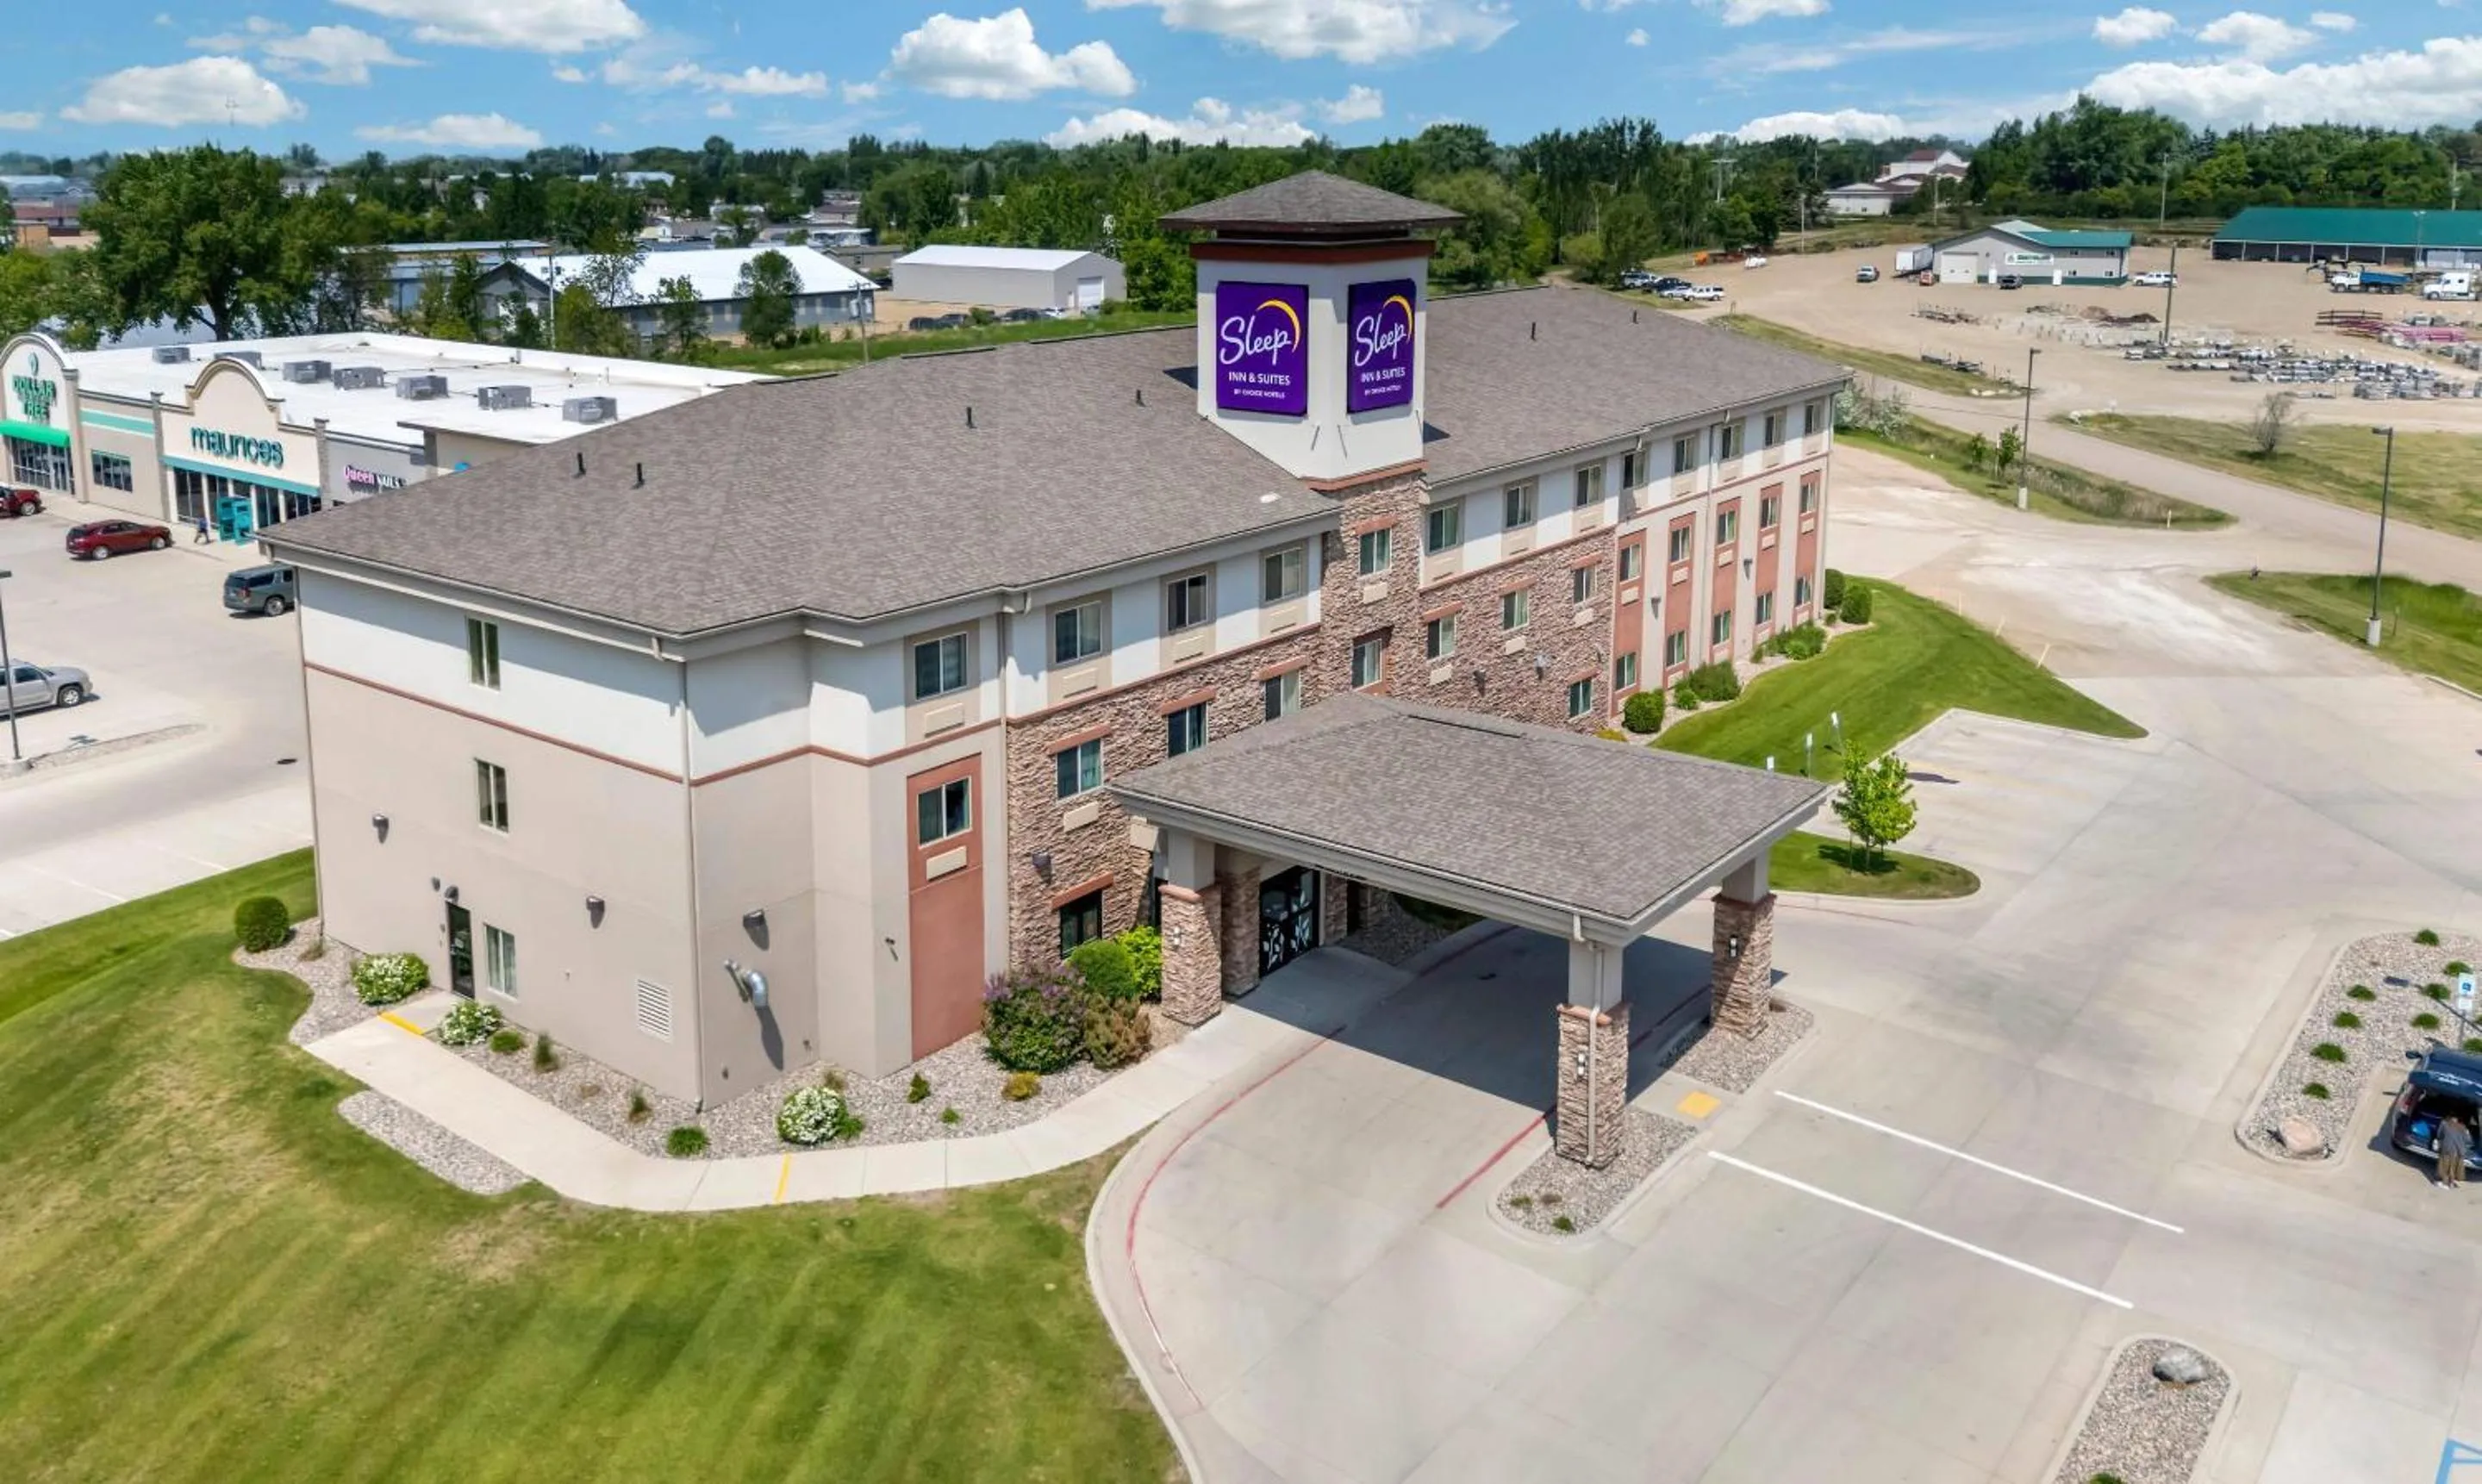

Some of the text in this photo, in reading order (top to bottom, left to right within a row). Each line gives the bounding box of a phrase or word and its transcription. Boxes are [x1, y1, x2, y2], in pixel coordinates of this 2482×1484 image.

[1219, 315, 1292, 365] Sleep
[1354, 312, 1407, 366] Sleep
[12, 375, 57, 400] DOLLAR
[1228, 371, 1291, 386] INN & SUITES
[190, 427, 284, 470] maurices
